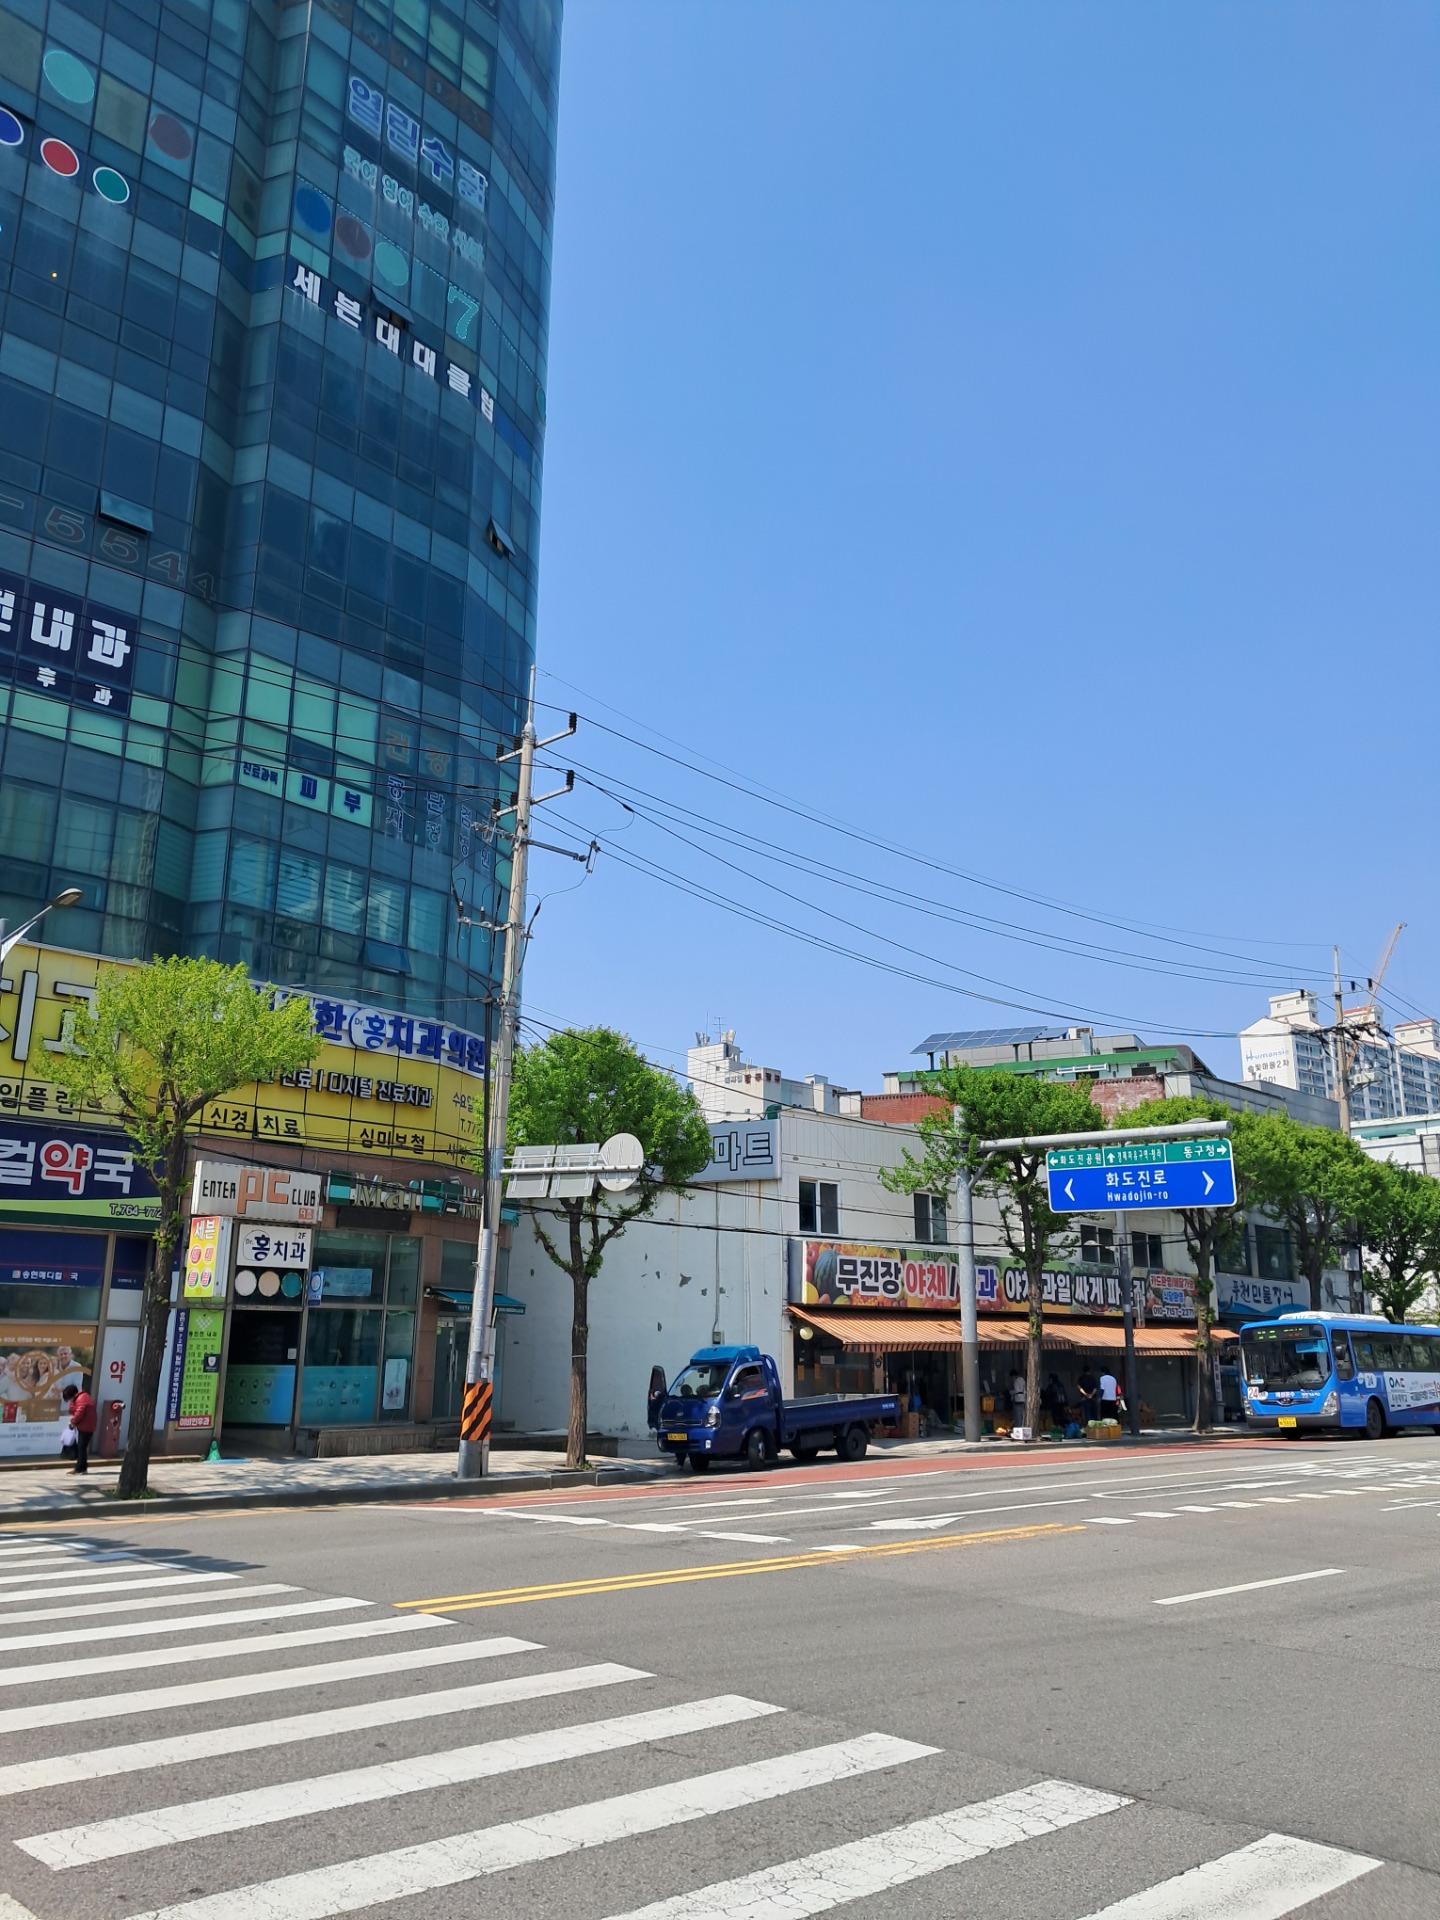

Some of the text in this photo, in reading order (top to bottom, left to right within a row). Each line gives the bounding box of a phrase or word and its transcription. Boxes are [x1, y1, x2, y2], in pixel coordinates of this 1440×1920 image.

[382, 174, 415, 221] 영어
[243, 762, 279, 785] 진료과목
[327, 1072, 374, 1099] 디지털
[376, 1079, 434, 1108] 진료치과
[262, 1114, 299, 1137] 치료
[359, 1127, 425, 1155] 심미보철
[1183, 1144, 1215, 1159] 동구청
[1059, 1153, 1101, 1166] 화도진공원
[1105, 1170, 1167, 1188] 화도진로
[202, 1180, 236, 1200] ENTER
[292, 1188, 316, 1207] CLUB
[1107, 1190, 1169, 1203] Hwadojin-ro
[194, 1219, 216, 1241] 세븐
[298, 1232, 306, 1240] 2F
[252, 1234, 306, 1263] 홍치과
[837, 1257, 901, 1296] 무진장
[904, 1261, 997, 1302] 야채/과
[1074, 1276, 1104, 1306] 싸게
[1231, 1279, 1295, 1307] 풍천민물장어
[110, 1360, 126, 1384] 약
[1248, 1387, 1259, 1399] 24
